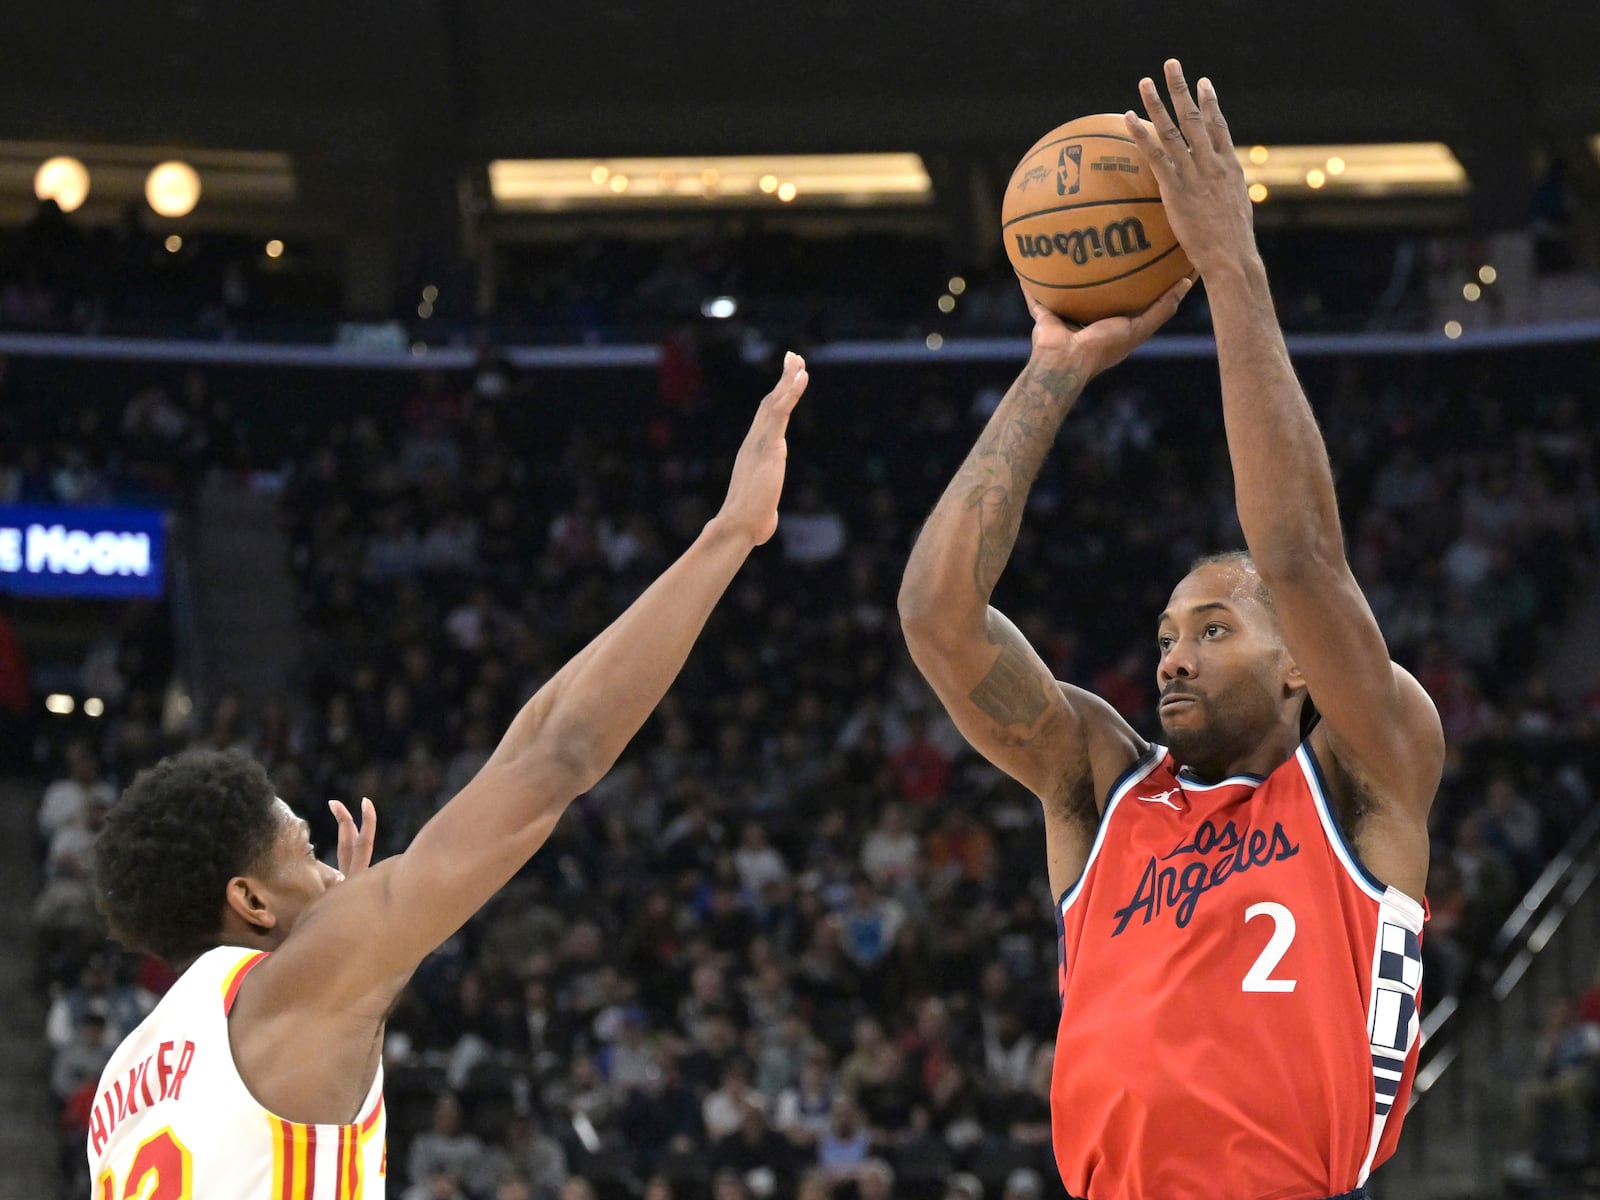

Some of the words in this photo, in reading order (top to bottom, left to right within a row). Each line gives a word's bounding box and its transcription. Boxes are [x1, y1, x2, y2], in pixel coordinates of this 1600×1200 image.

[1015, 216, 1151, 265] Wilson
[1160, 820, 1241, 861] Los
[1111, 821, 1300, 938] Angeles
[1241, 901, 1297, 993] 2
